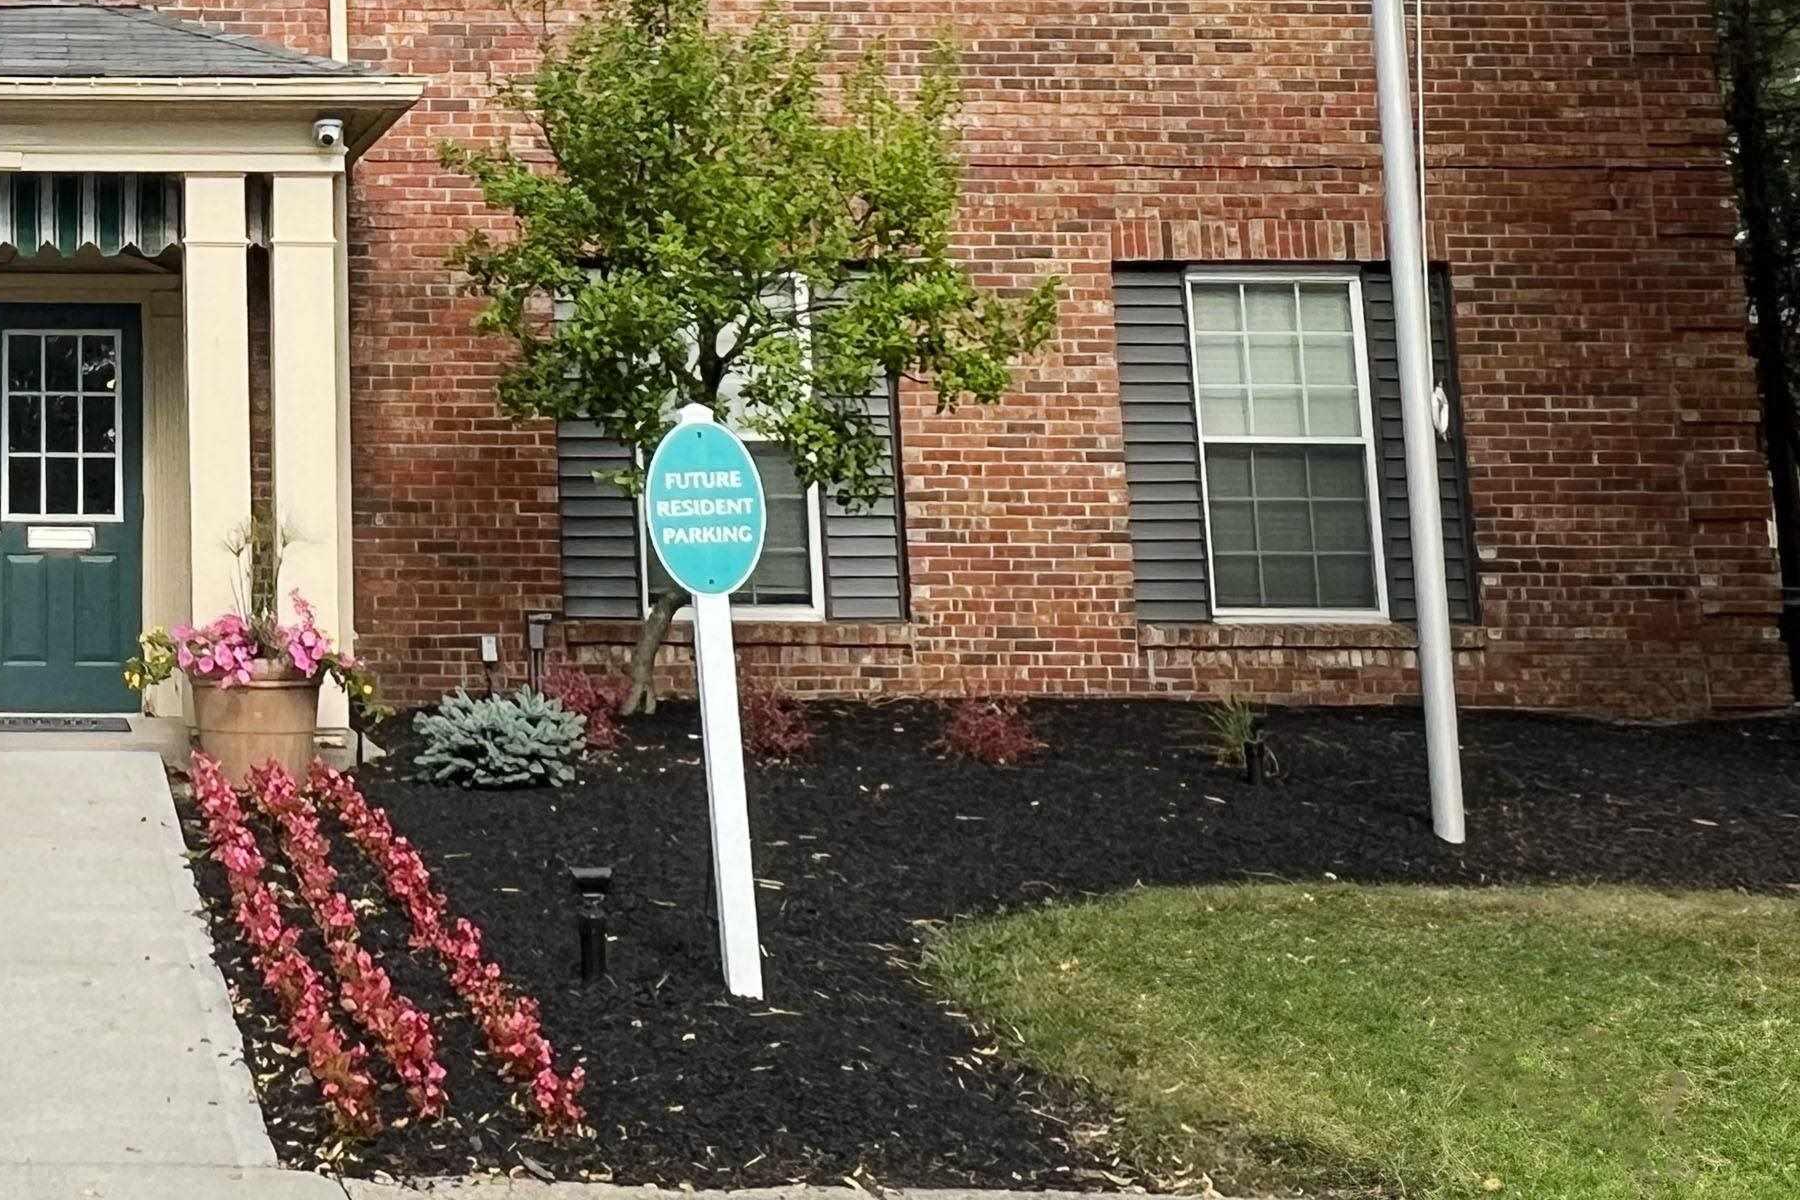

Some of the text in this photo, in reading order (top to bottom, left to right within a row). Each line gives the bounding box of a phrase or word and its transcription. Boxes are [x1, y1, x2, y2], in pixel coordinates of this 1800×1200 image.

[664, 470, 742, 490] FUTURE
[656, 497, 754, 517] RESIDENT
[662, 524, 754, 544] PARKING
